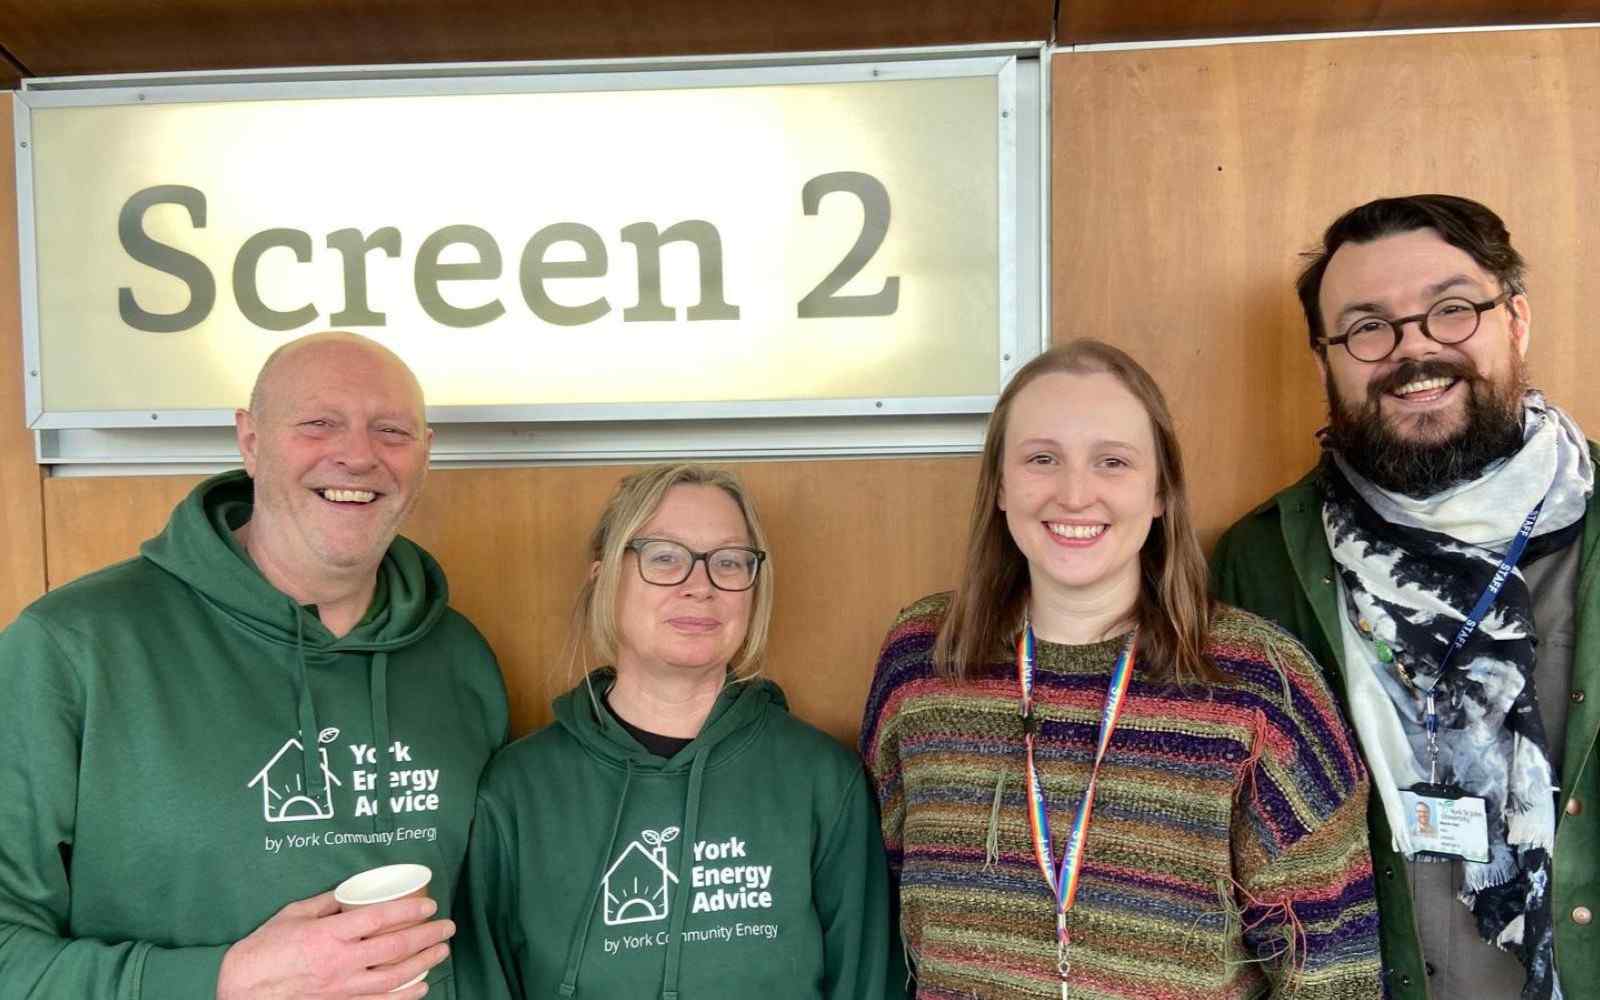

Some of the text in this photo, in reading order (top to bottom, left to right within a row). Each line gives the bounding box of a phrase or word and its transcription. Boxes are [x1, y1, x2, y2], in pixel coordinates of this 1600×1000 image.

[117, 171, 901, 333] Screen 2
[1520, 509, 1540, 536] STAFF
[1489, 563, 1512, 594] STAFF
[1455, 619, 1476, 649] STAFF
[349, 741, 412, 765] Yok
[265, 837, 282, 853] by
[287, 833, 320, 848] York
[694, 836, 746, 861] York
[692, 865, 772, 889] Energy
[692, 887, 772, 913] Advice
[604, 938, 620, 954] by
[623, 934, 653, 949] York
[735, 922, 778, 938] Energy
